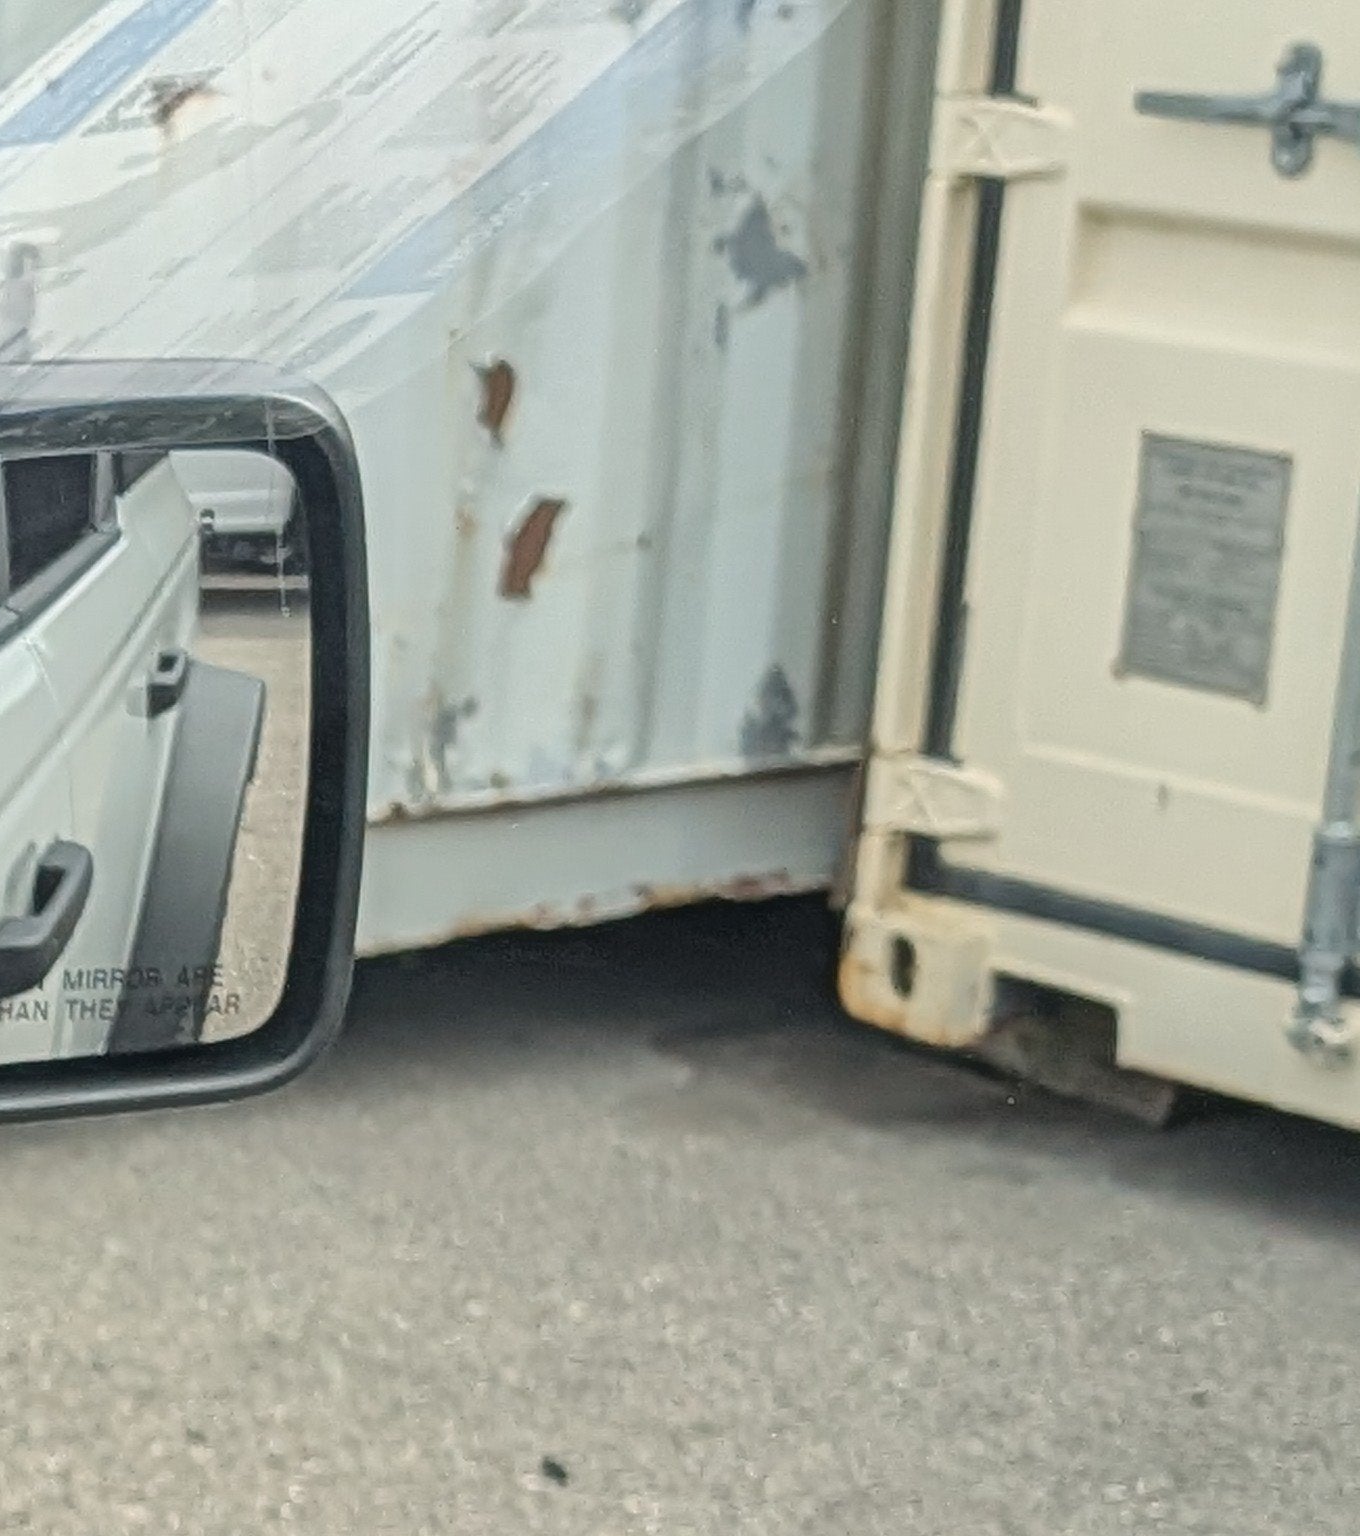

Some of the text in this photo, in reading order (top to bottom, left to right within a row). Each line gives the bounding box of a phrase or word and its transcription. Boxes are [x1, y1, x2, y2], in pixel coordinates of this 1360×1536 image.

[63, 967, 162, 990] MIRROR
[178, 963, 223, 987] ARE
[66, 997, 128, 1021] THE
